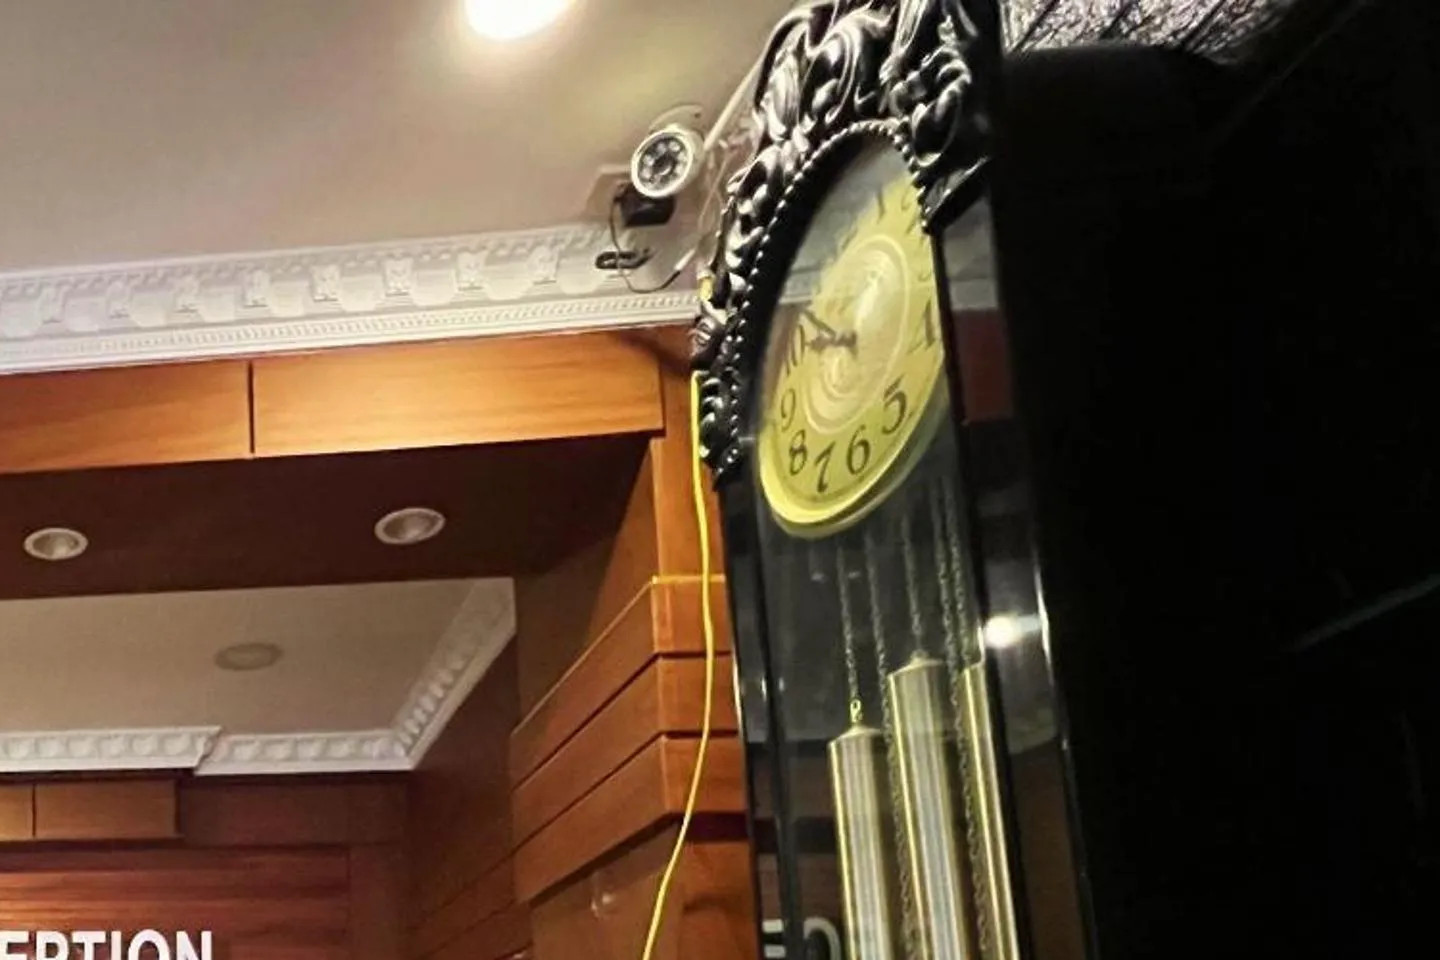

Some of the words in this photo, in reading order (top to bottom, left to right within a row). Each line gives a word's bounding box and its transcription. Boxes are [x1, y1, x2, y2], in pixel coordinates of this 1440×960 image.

[780, 388, 796, 432] 9
[881, 373, 907, 434] 5
[789, 429, 807, 476] 8
[814, 441, 836, 493] 7
[846, 424, 870, 475] 6
